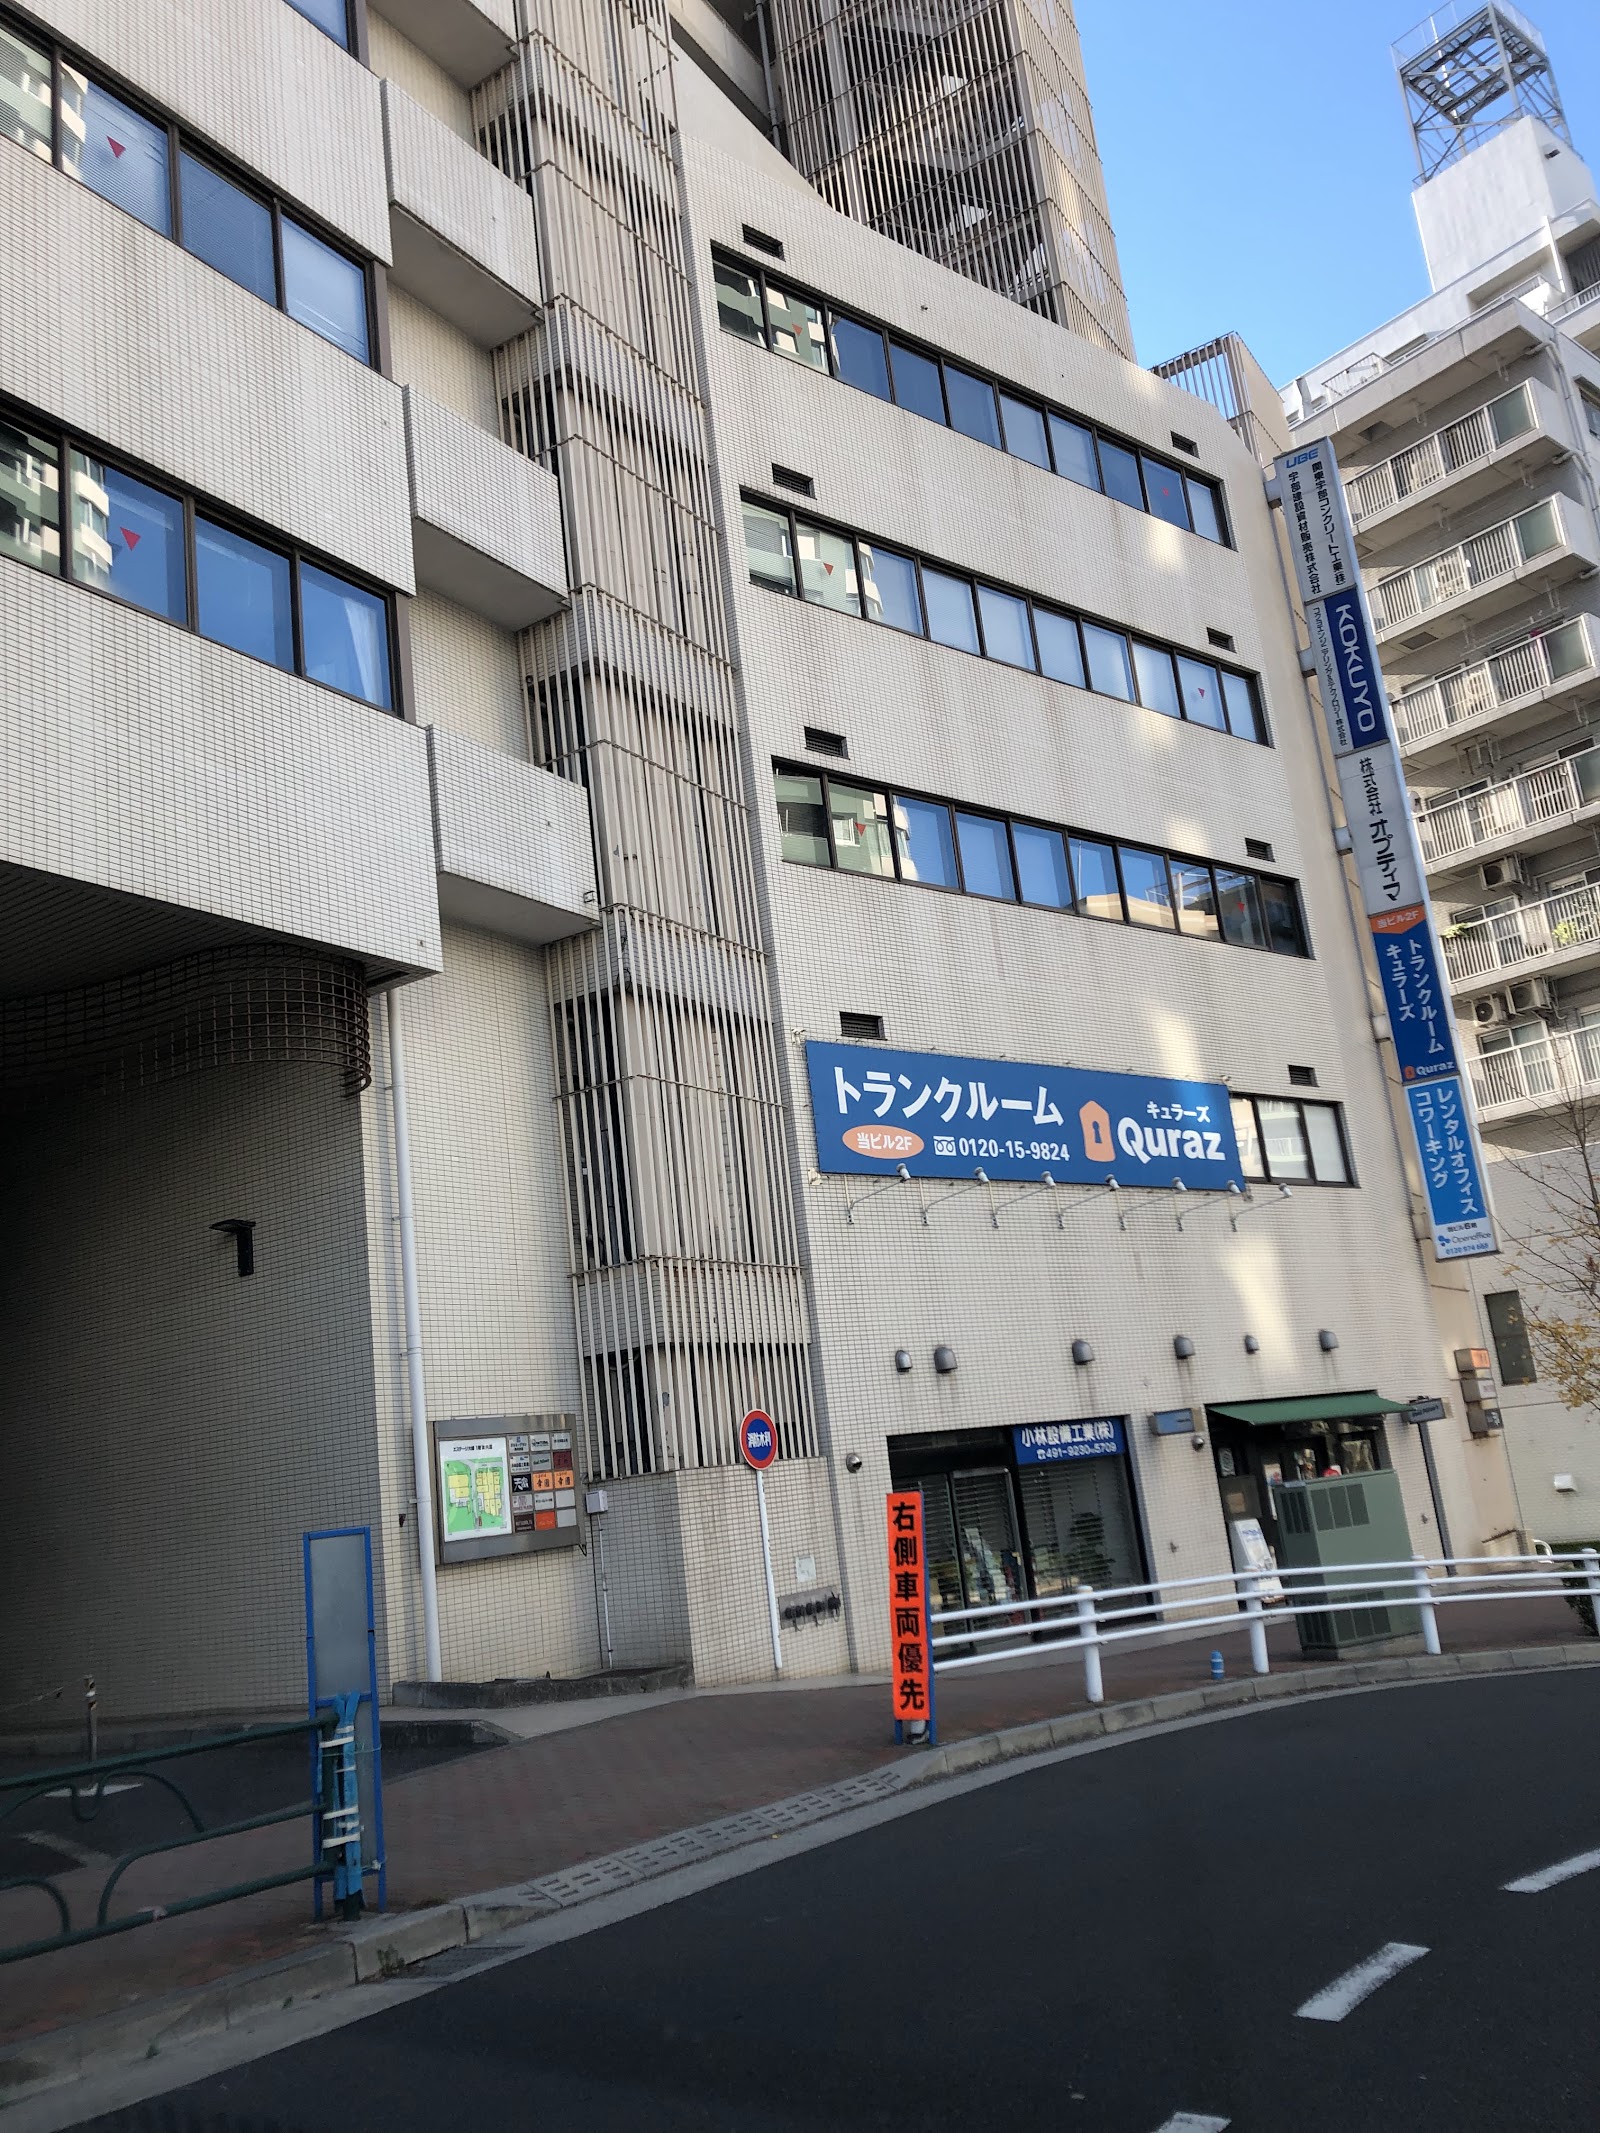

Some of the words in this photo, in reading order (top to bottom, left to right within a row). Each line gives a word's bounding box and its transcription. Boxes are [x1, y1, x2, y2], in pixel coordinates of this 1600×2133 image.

[1286, 448, 1319, 469] UBE
[1289, 471, 1322, 594] 宇部建設資材販売株式会社
[1336, 604, 1375, 732] KOKUYO
[1360, 757, 1383, 815] 株式会社
[1370, 819, 1401, 901] オプティマ
[1376, 910, 1419, 929] 当ビル2F
[1386, 944, 1415, 1022] キュラーズ
[1409, 939, 1445, 1054] トランクルーム
[833, 1066, 1065, 1127] トランクルーム
[1417, 1060, 1455, 1076] Quraz
[1117, 1116, 1226, 1165] Quraz
[1146, 1100, 1210, 1123] キュラーズ
[1415, 1091, 1449, 1189] コワーキング
[857, 1131, 914, 1152] 当ビル2F
[958, 1136, 1071, 1162] 0120-15-9824
[1437, 1088, 1479, 1216] レンタルオフィス
[1021, 1420, 1114, 1448] 小林設備工業(株)
[892, 1502, 925, 1711] 右側車両優先
